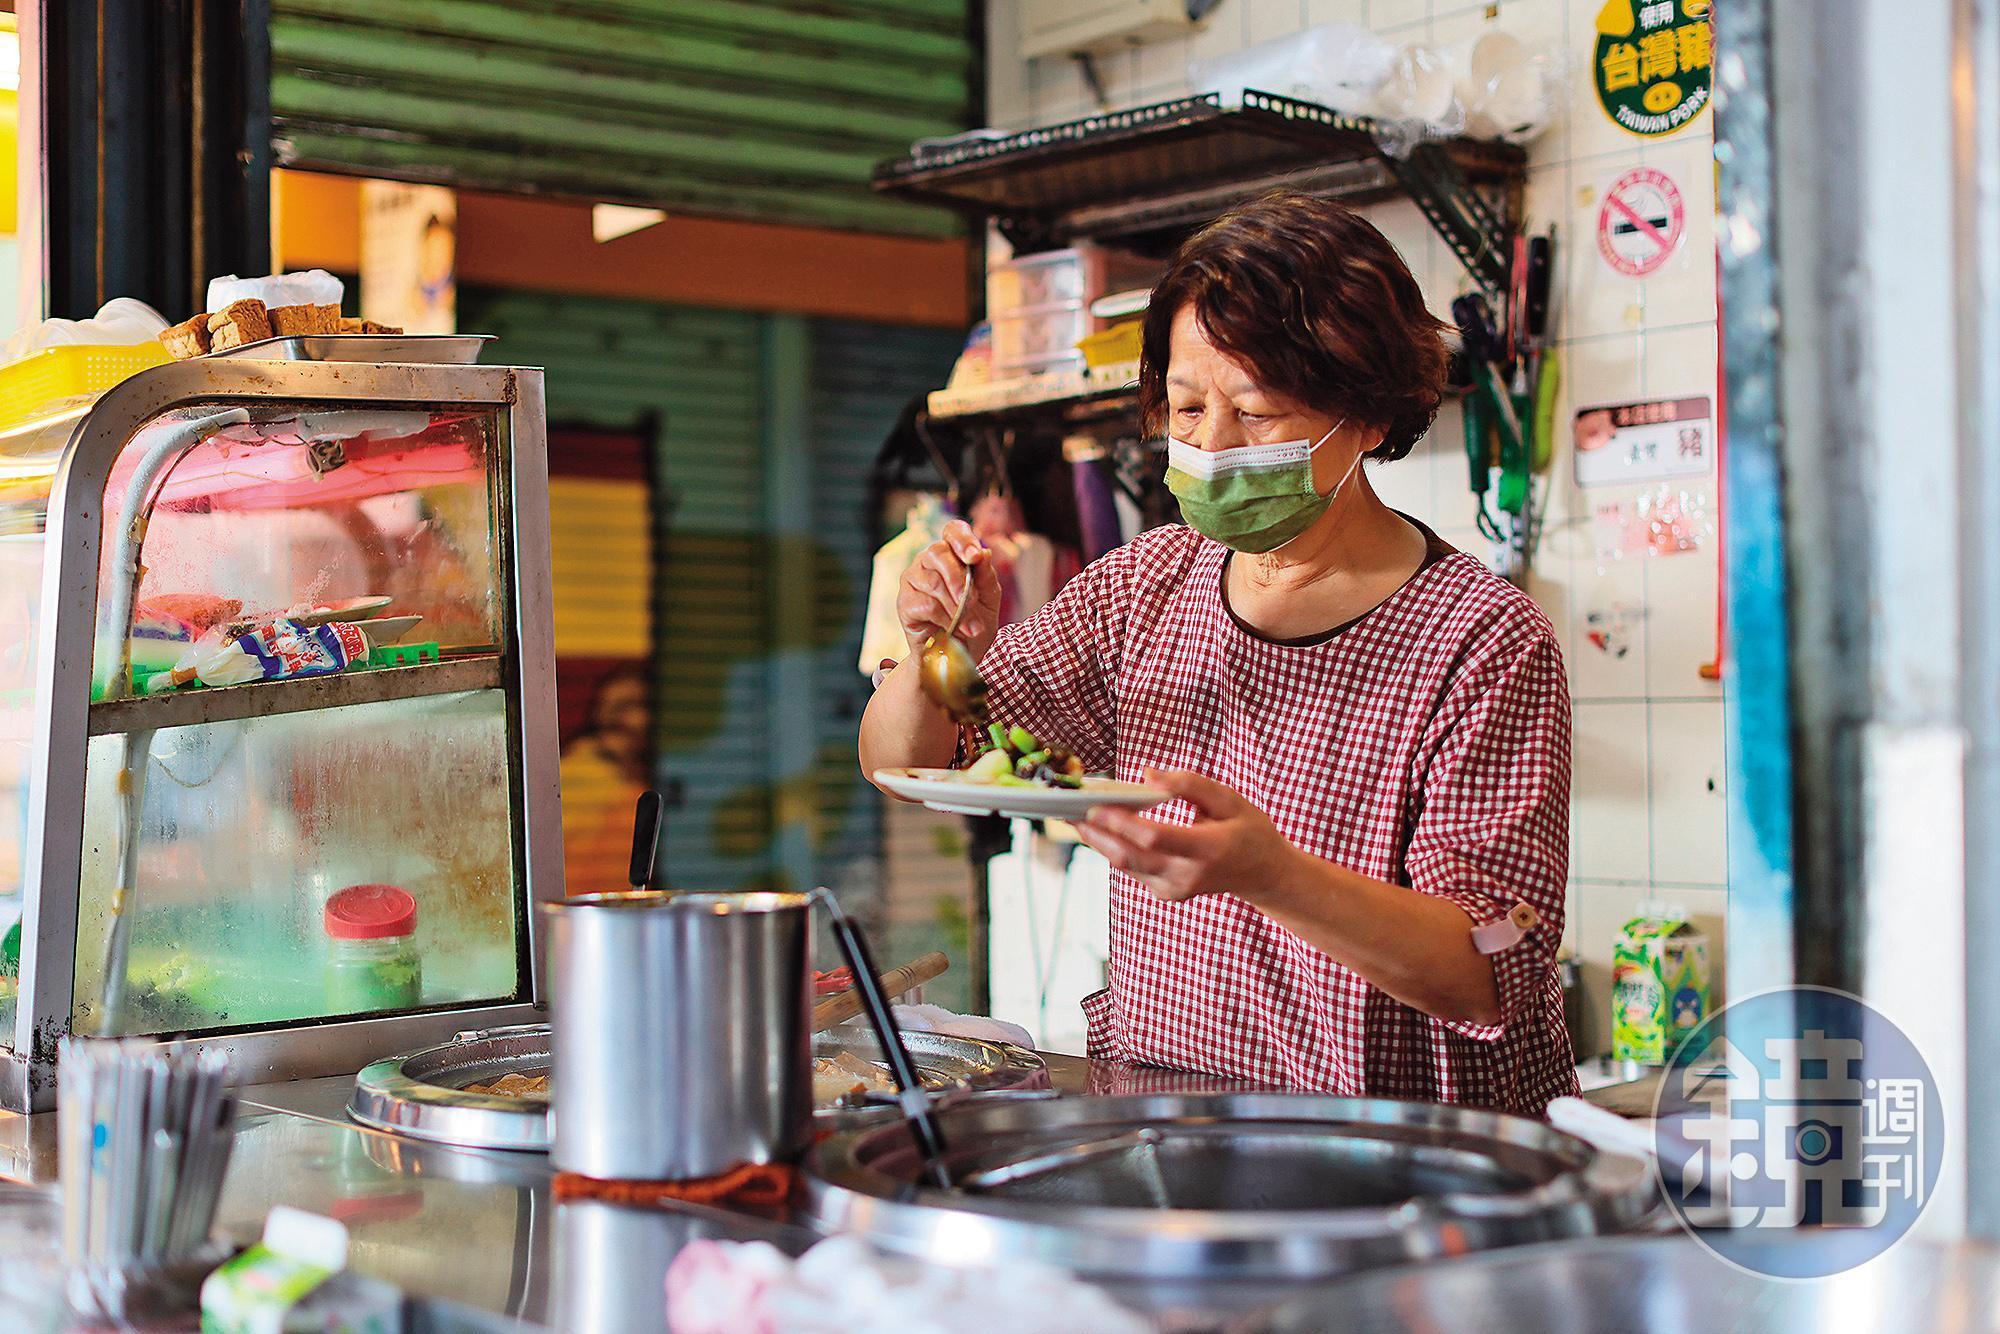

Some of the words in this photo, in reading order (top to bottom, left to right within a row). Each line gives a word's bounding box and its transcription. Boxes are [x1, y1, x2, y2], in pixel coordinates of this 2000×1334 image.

[1639, 1, 1674, 30] 使用
[1602, 21, 1712, 93] 台灣豬
[1616, 104, 1670, 132] TAIWAN
[1670, 86, 1708, 127] PORK
